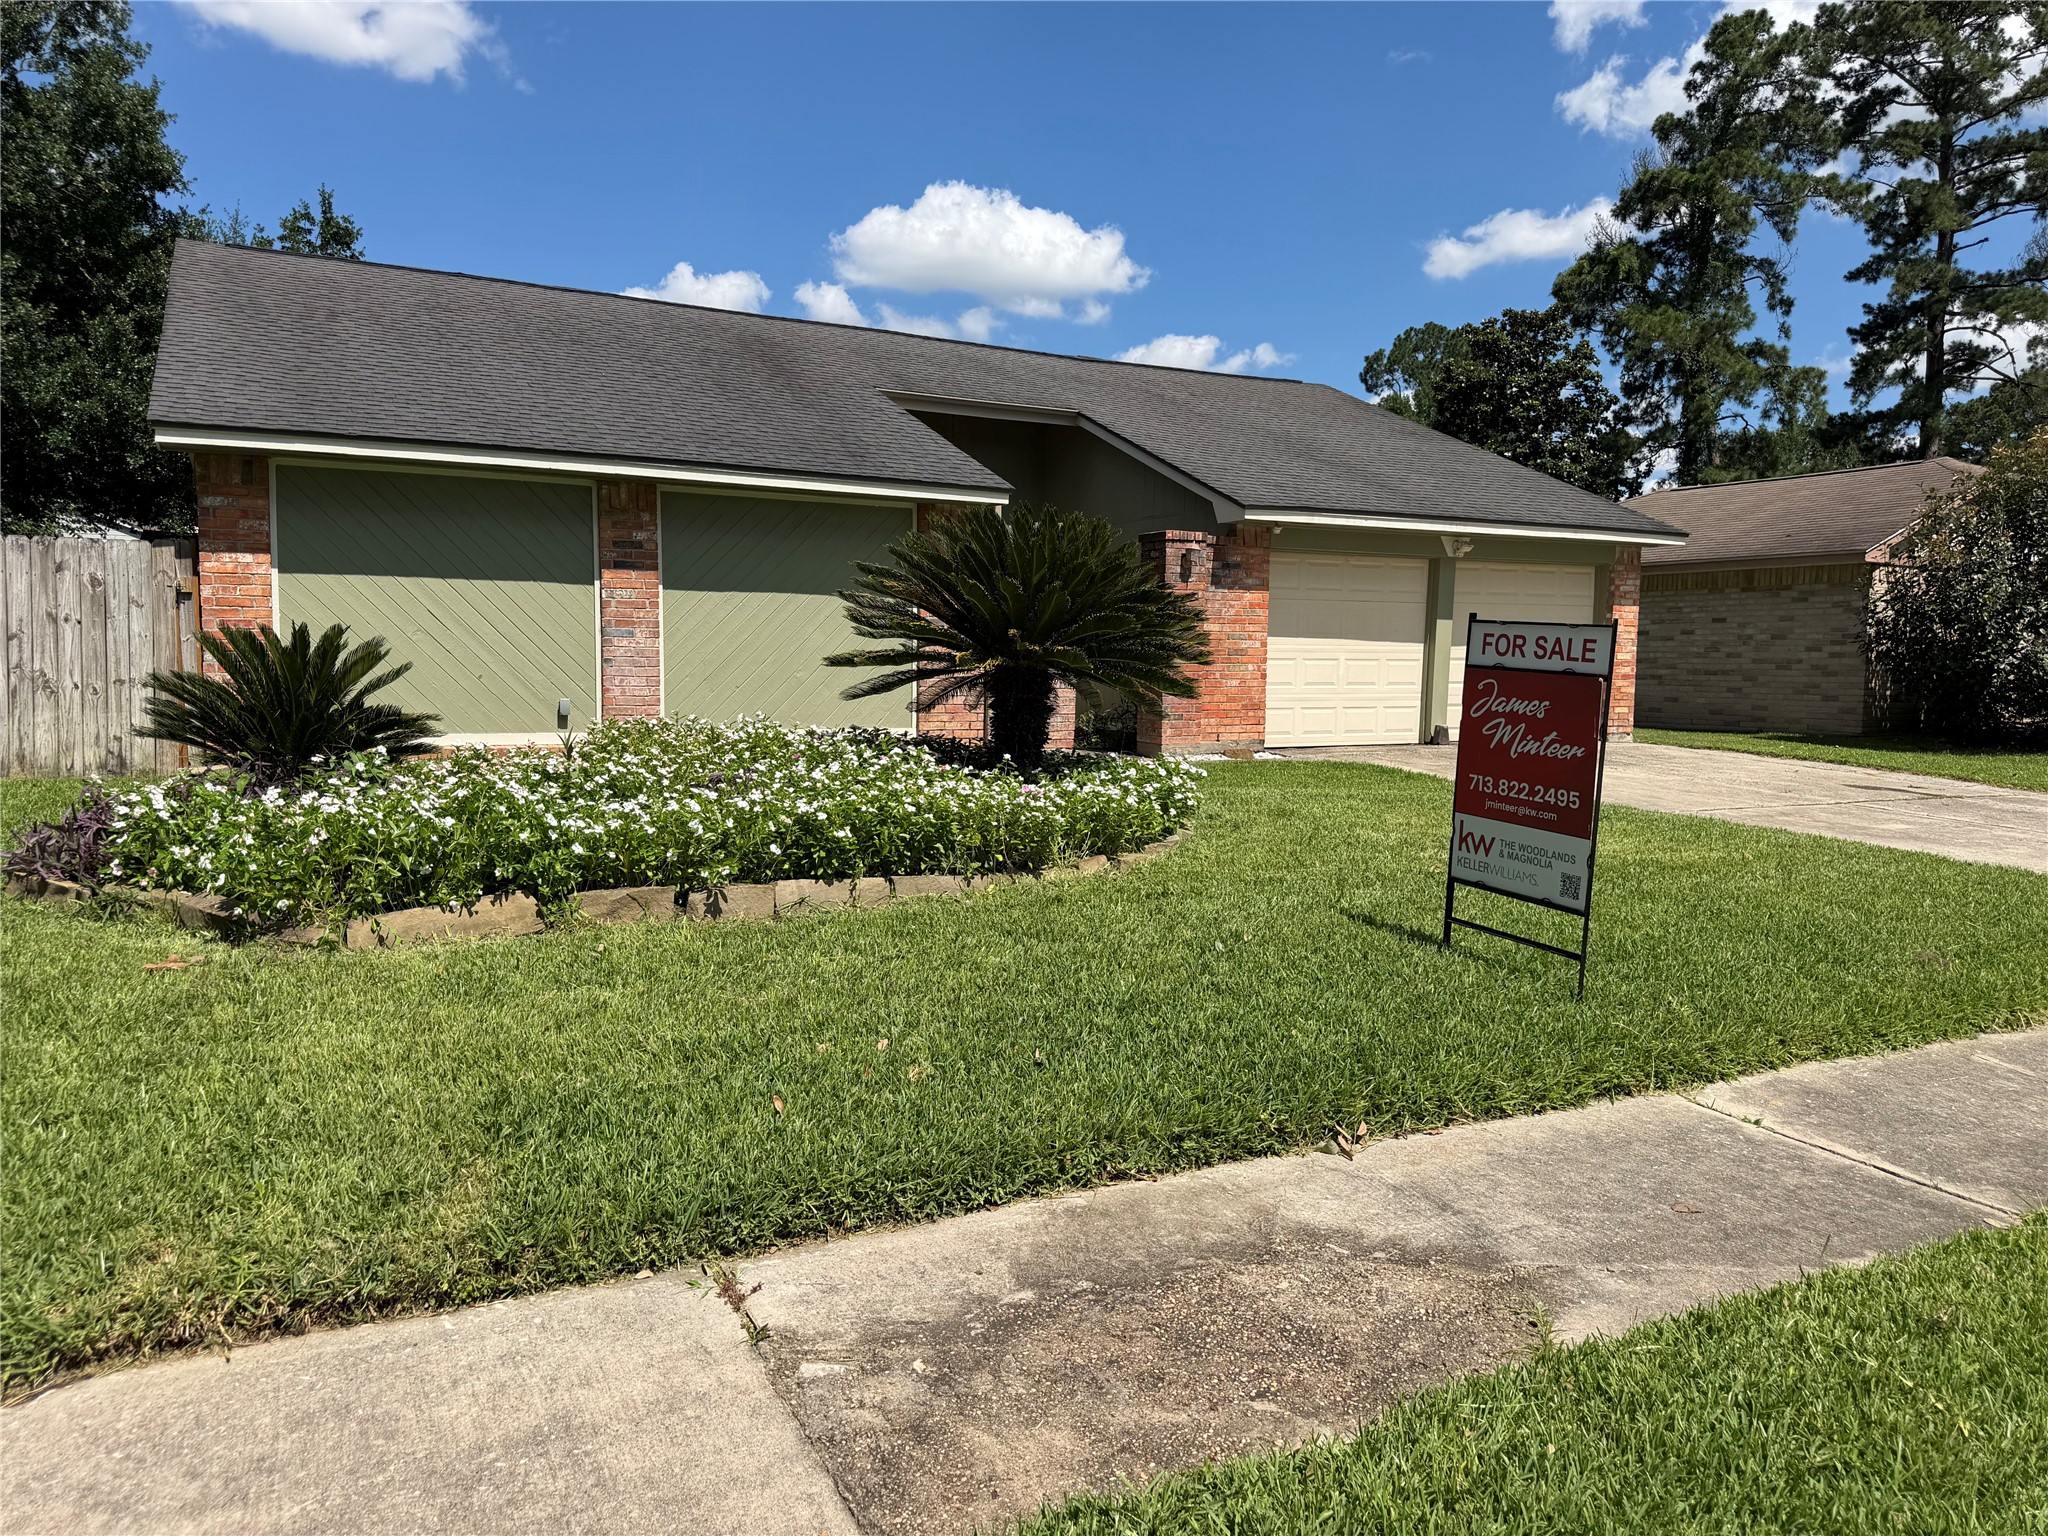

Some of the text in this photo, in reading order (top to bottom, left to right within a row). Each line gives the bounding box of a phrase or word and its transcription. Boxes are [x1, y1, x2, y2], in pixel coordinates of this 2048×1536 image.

[1481, 632, 1598, 663] FOR SALE
[1469, 678, 1552, 719] James
[1481, 717, 1586, 760] Minteer
[1468, 773, 1581, 810] 713.822.2495
[1484, 798, 1558, 821] jminteer@kw.com
[1457, 819, 1496, 858] kw
[1499, 838, 1577, 865] THE WOODLANDS
[1498, 849, 1554, 871] & MAGNOLIA
